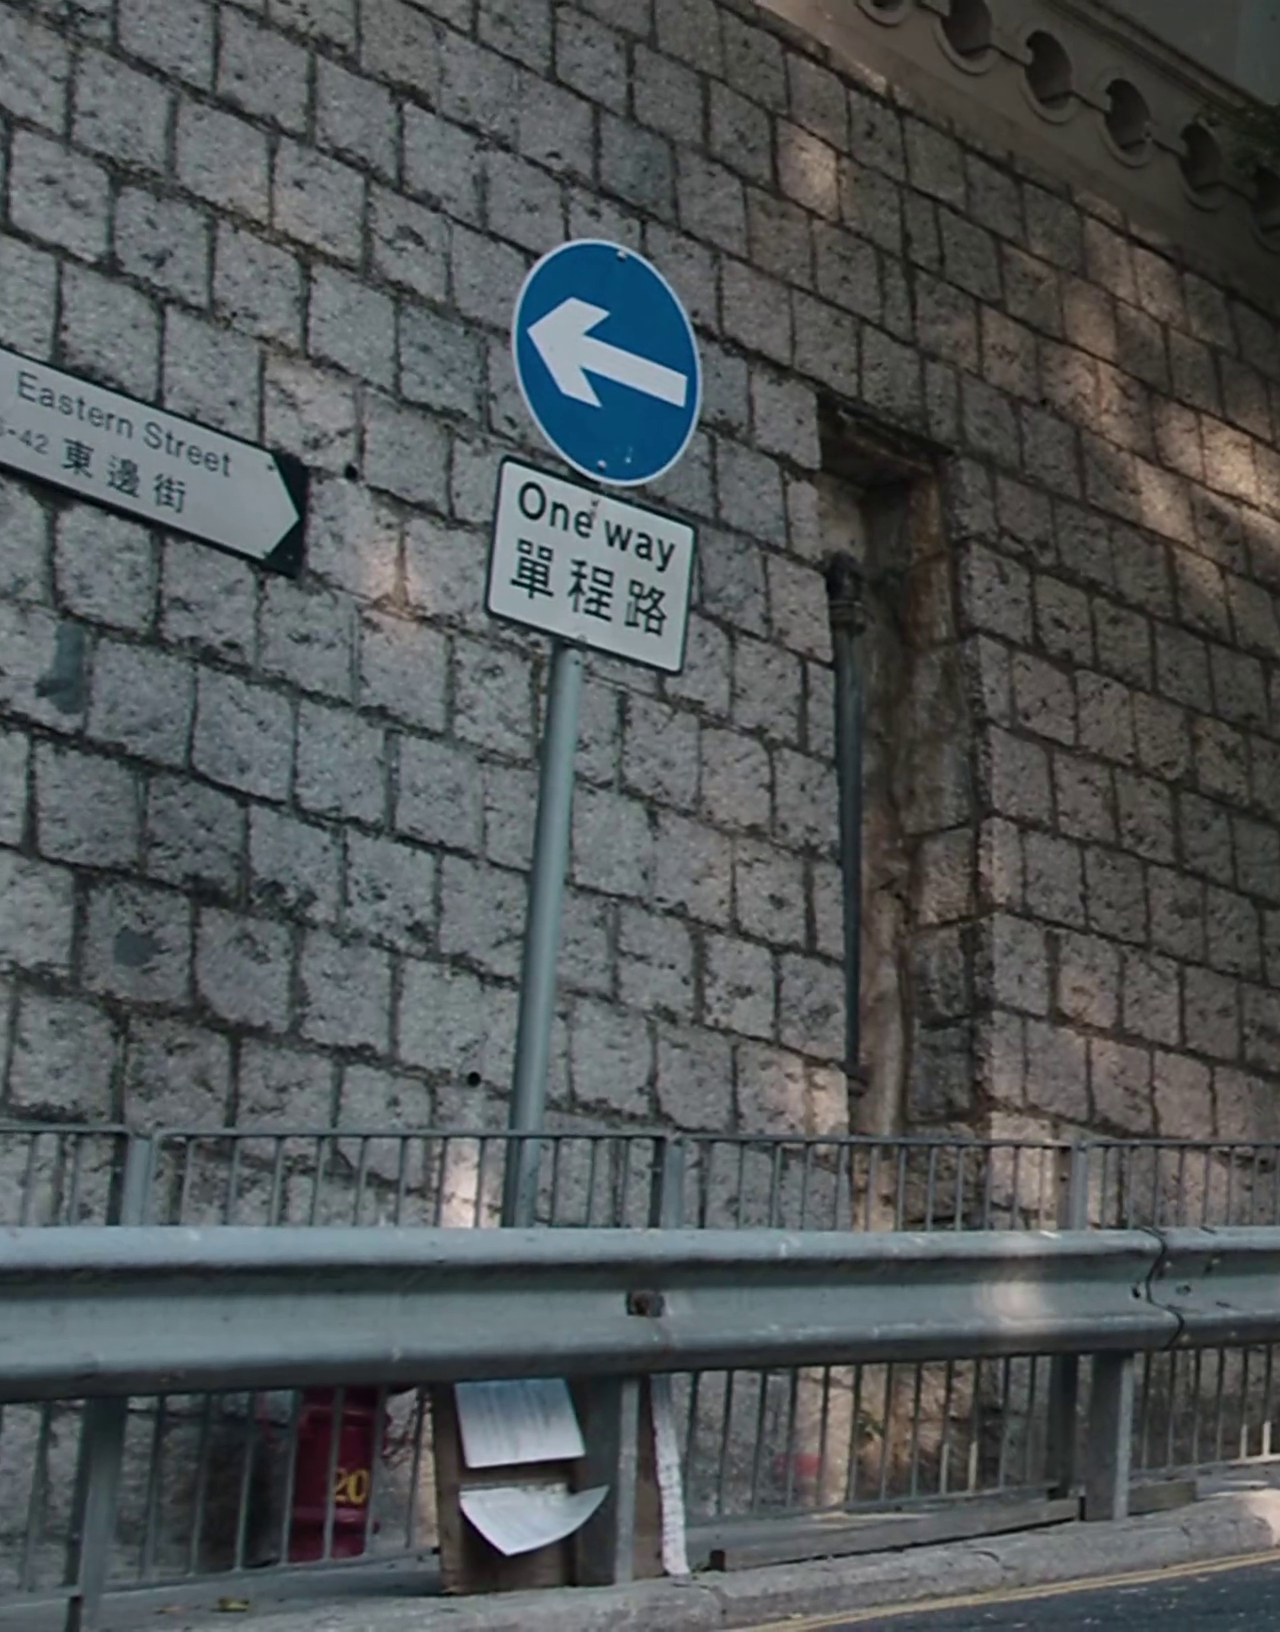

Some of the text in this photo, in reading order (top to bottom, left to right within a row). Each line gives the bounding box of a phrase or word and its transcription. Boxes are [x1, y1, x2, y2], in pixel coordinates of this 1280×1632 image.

[17, 370, 232, 477] Eastern Street
[60, 437, 186, 514] 東邊街
[518, 481, 676, 573] One way
[510, 538, 667, 637] 單程路
[334, 1468, 369, 1504] 20
